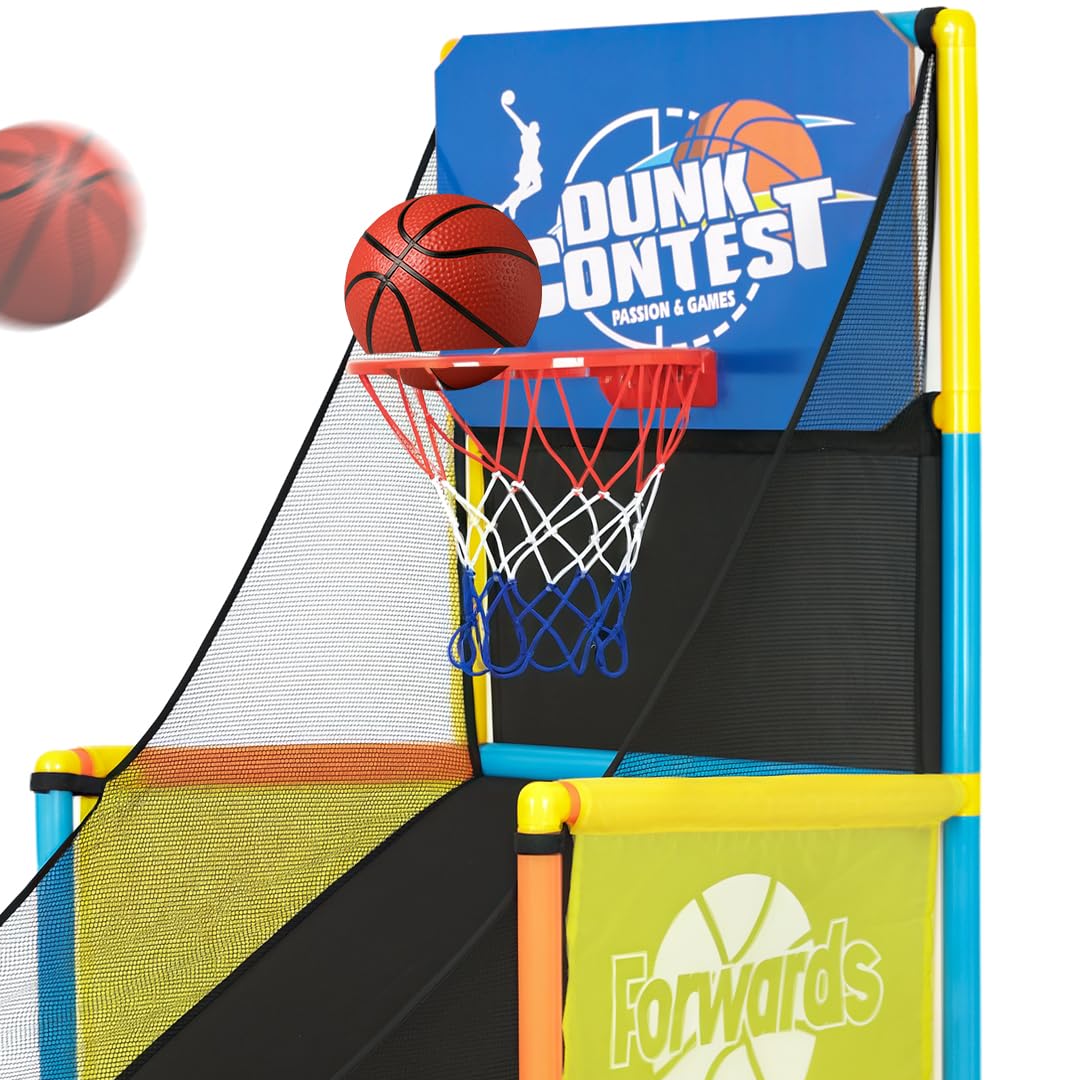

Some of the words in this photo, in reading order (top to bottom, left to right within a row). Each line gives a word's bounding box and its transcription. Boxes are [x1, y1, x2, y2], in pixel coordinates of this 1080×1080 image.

[561, 151, 756, 246] DUNK
[611, 301, 670, 327] PASSION
[673, 298, 684, 316] &
[687, 290, 736, 314] GAMES
[610, 916, 884, 1070] Forwards
